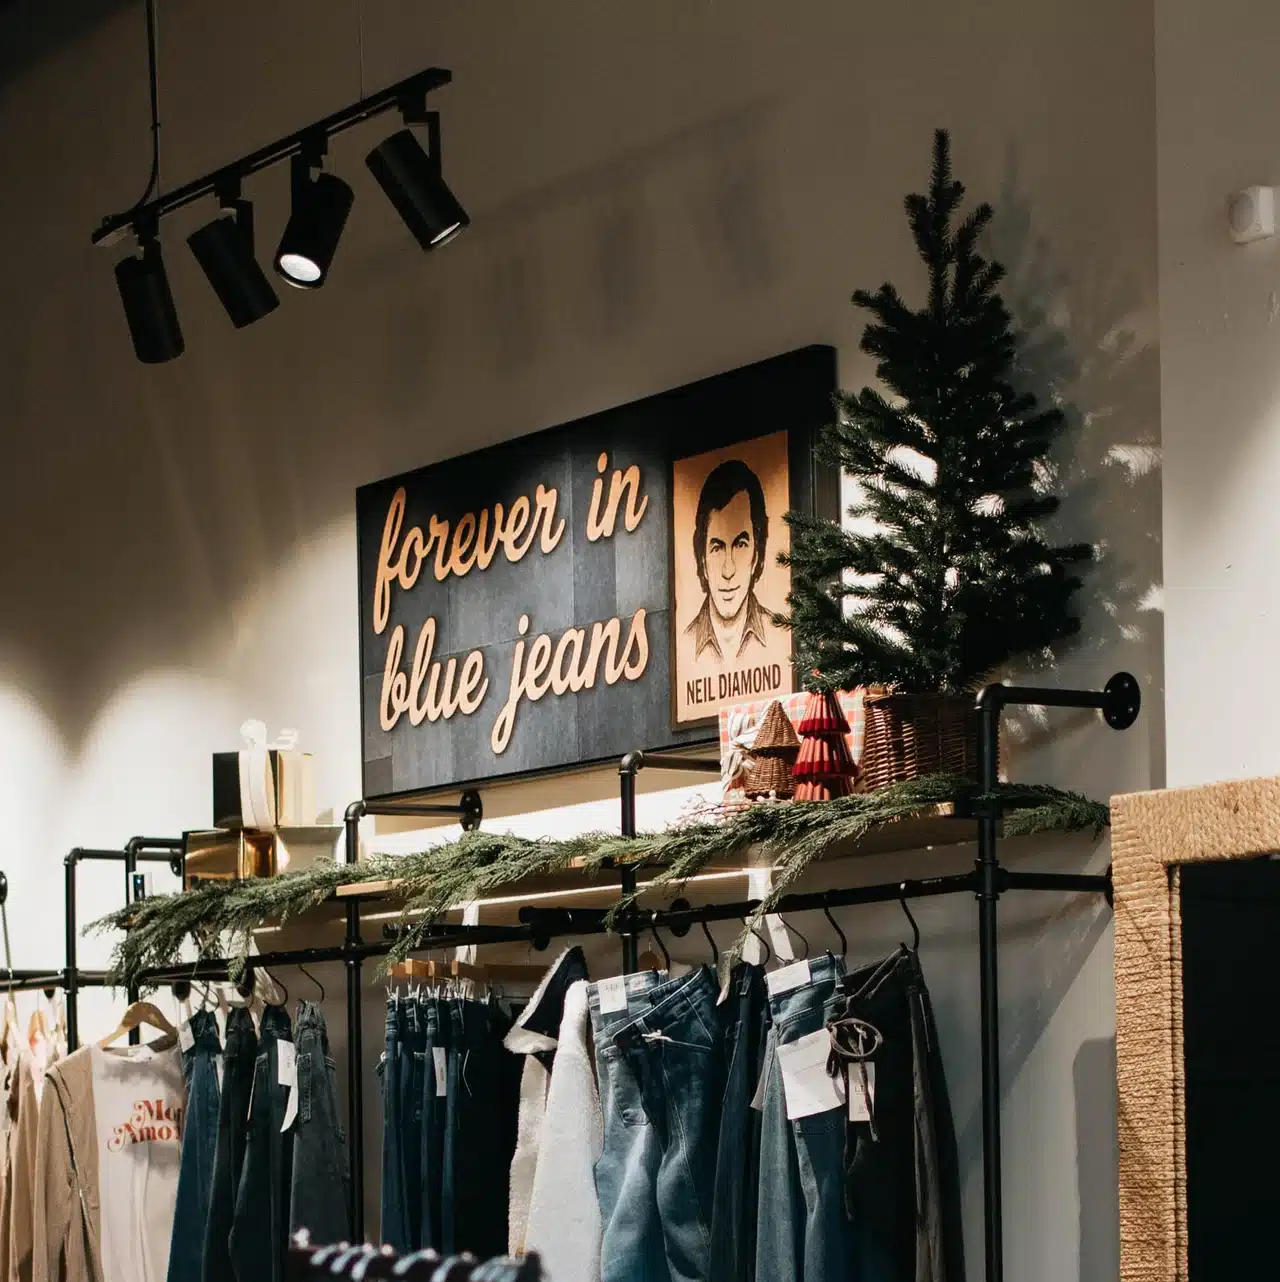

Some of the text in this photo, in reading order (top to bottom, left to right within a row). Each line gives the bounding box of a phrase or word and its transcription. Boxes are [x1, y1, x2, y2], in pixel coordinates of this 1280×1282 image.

[372, 450, 649, 635] forever in
[379, 607, 650, 755] blue jeans
[686, 663, 782, 706] NEIL DIAMOND
